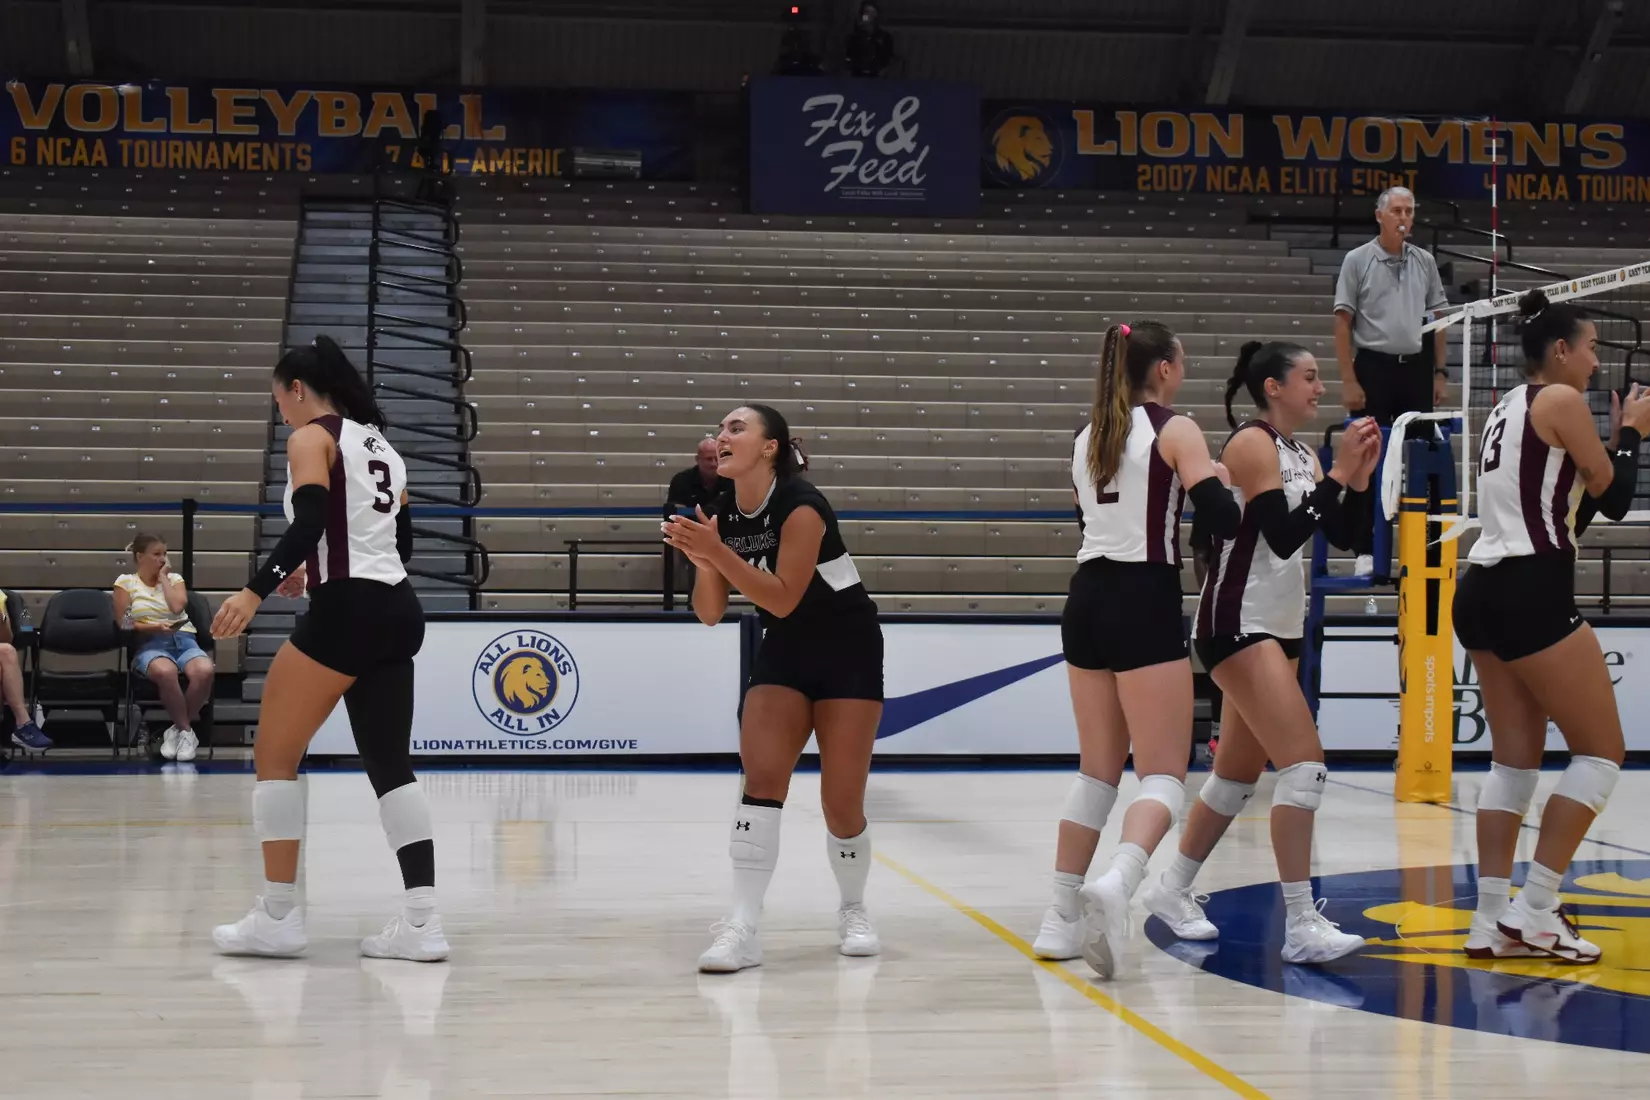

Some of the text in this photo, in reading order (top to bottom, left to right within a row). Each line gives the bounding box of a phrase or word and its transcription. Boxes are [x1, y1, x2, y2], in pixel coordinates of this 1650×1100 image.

[6, 82, 506, 141] VOLLEYBALL
[802, 94, 920, 155] Fix &
[11, 137, 26, 164] 6
[37, 137, 108, 167] NCAA
[119, 139, 312, 171] TOURNAMENTS
[821, 140, 930, 192] Feed
[1072, 110, 1627, 169] LION WOMEN'S
[1136, 165, 1198, 192] 2007
[1206, 166, 1270, 194] NCAA
[1506, 173, 1569, 200] NCAA
[1478, 418, 1507, 477] 13
[368, 459, 395, 513] 3
[478, 635, 573, 676] ALL LIONS
[490, 707, 561, 732] ALL IN
[1424, 655, 1436, 743] sports imports
[412, 739, 638, 750] LIONATHLETICS.COM/GIVE
